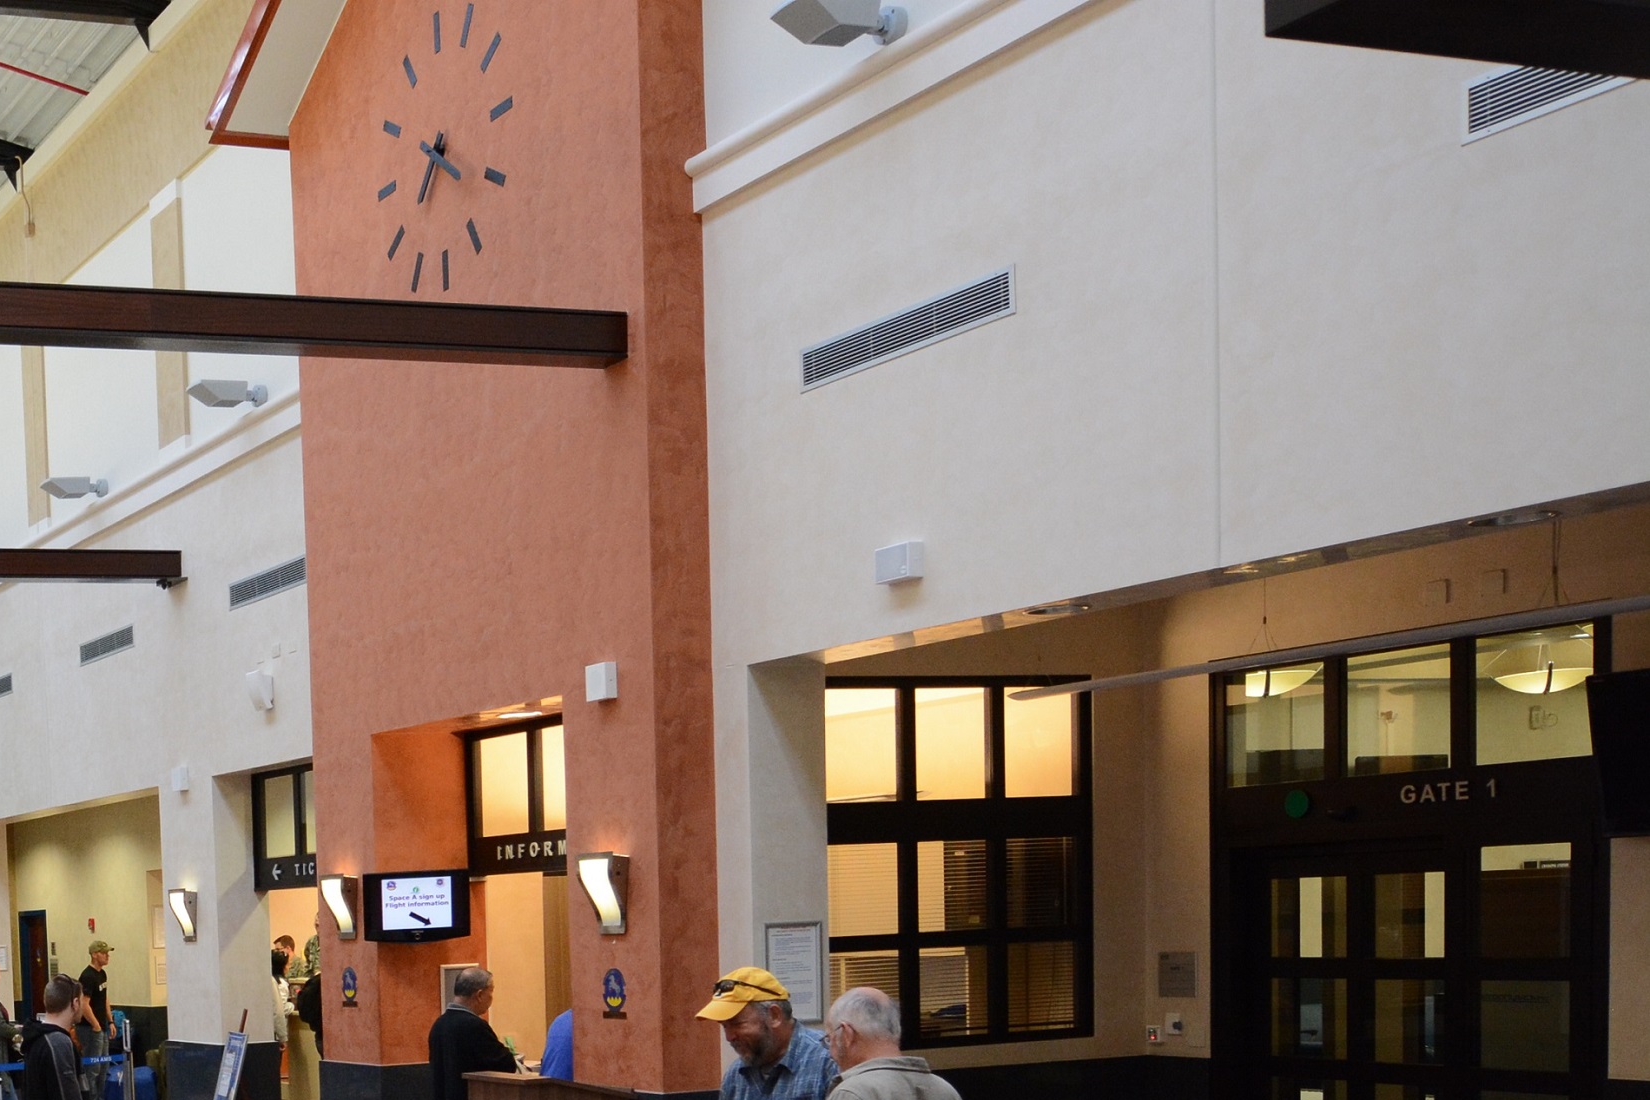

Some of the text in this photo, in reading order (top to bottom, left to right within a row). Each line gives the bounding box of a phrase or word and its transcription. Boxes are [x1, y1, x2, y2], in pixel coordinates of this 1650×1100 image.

[1400, 778, 1495, 804] GATE 1
[496, 839, 567, 861] INFORM
[294, 861, 315, 876] TIC
[407, 900, 449, 908] information
